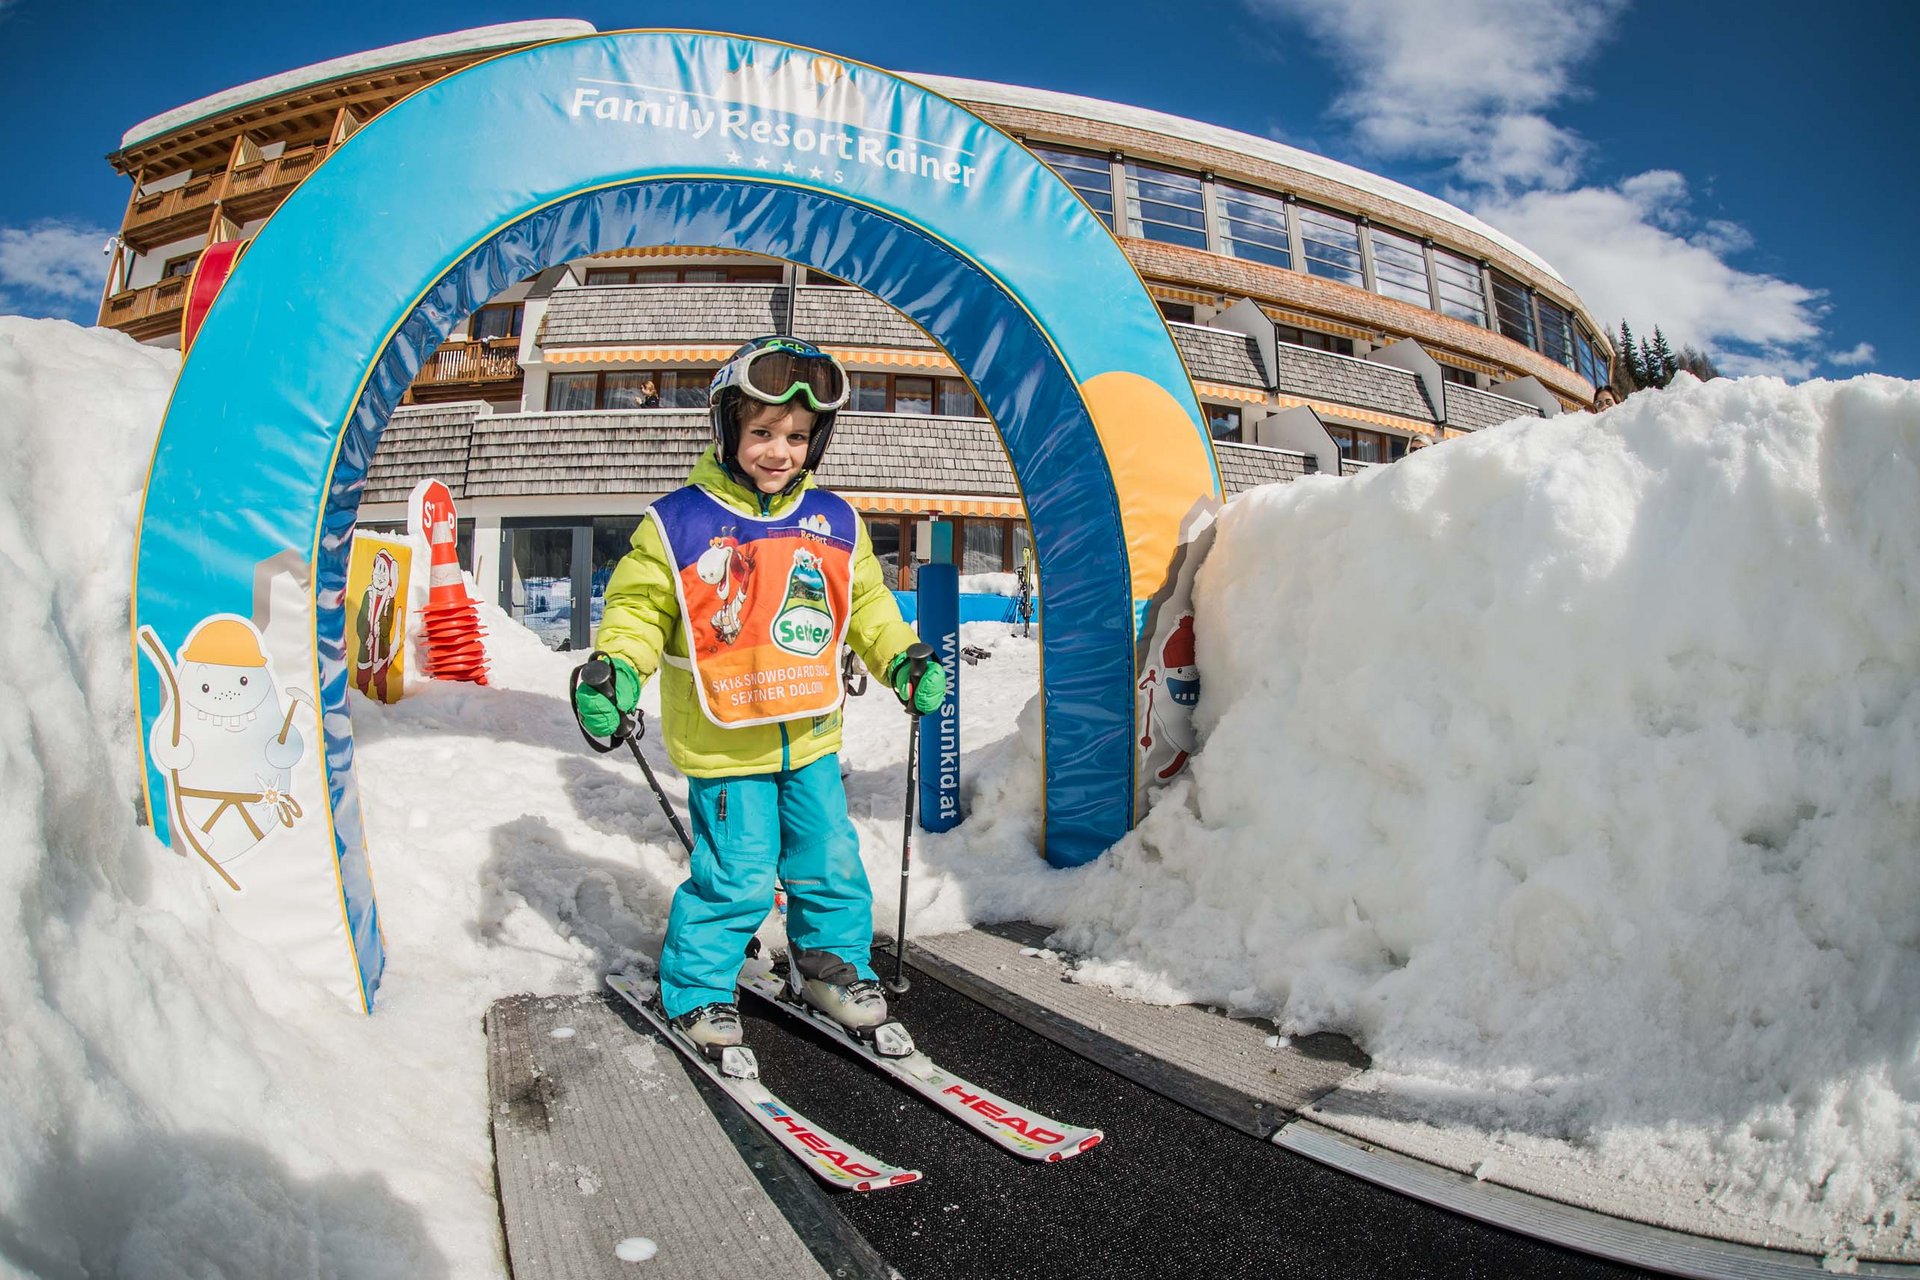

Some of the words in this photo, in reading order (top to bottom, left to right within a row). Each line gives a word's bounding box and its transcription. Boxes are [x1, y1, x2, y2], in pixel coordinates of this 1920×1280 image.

[572, 88, 714, 140] Family
[719, 108, 853, 160] Resort
[858, 136, 976, 187] Rainer
[424, 501, 455, 529] SP
[801, 529, 827, 545] Resort
[731, 686, 785, 706] SEXTNER
[940, 632, 958, 819] www.sunkid.at
[943, 1085, 1065, 1144] HEAD
[773, 1116, 881, 1178] HEAD
